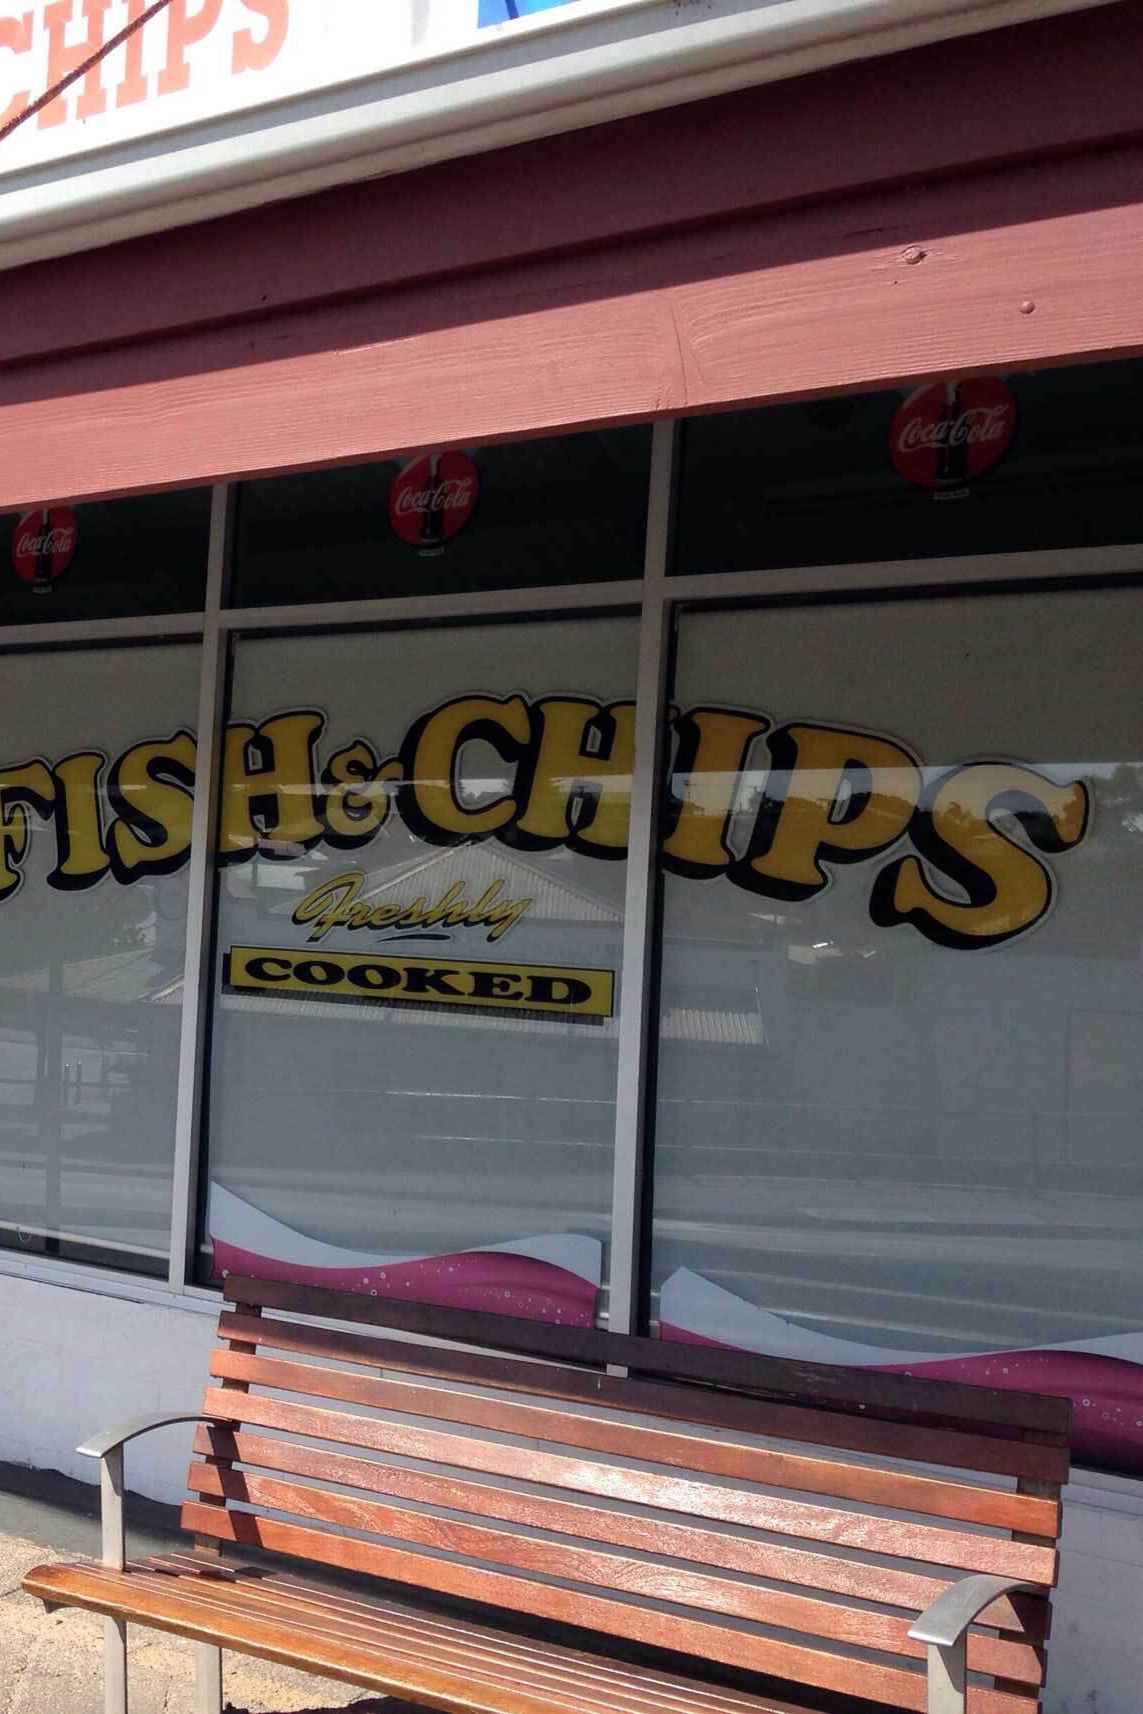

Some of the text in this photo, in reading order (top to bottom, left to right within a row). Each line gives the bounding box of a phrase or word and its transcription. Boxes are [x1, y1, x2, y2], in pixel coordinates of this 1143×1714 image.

[323, 738, 404, 851] &
[399, 694, 1089, 950] CHIPS
[291, 871, 534, 943] Freshly
[244, 956, 593, 1005] COOKED
